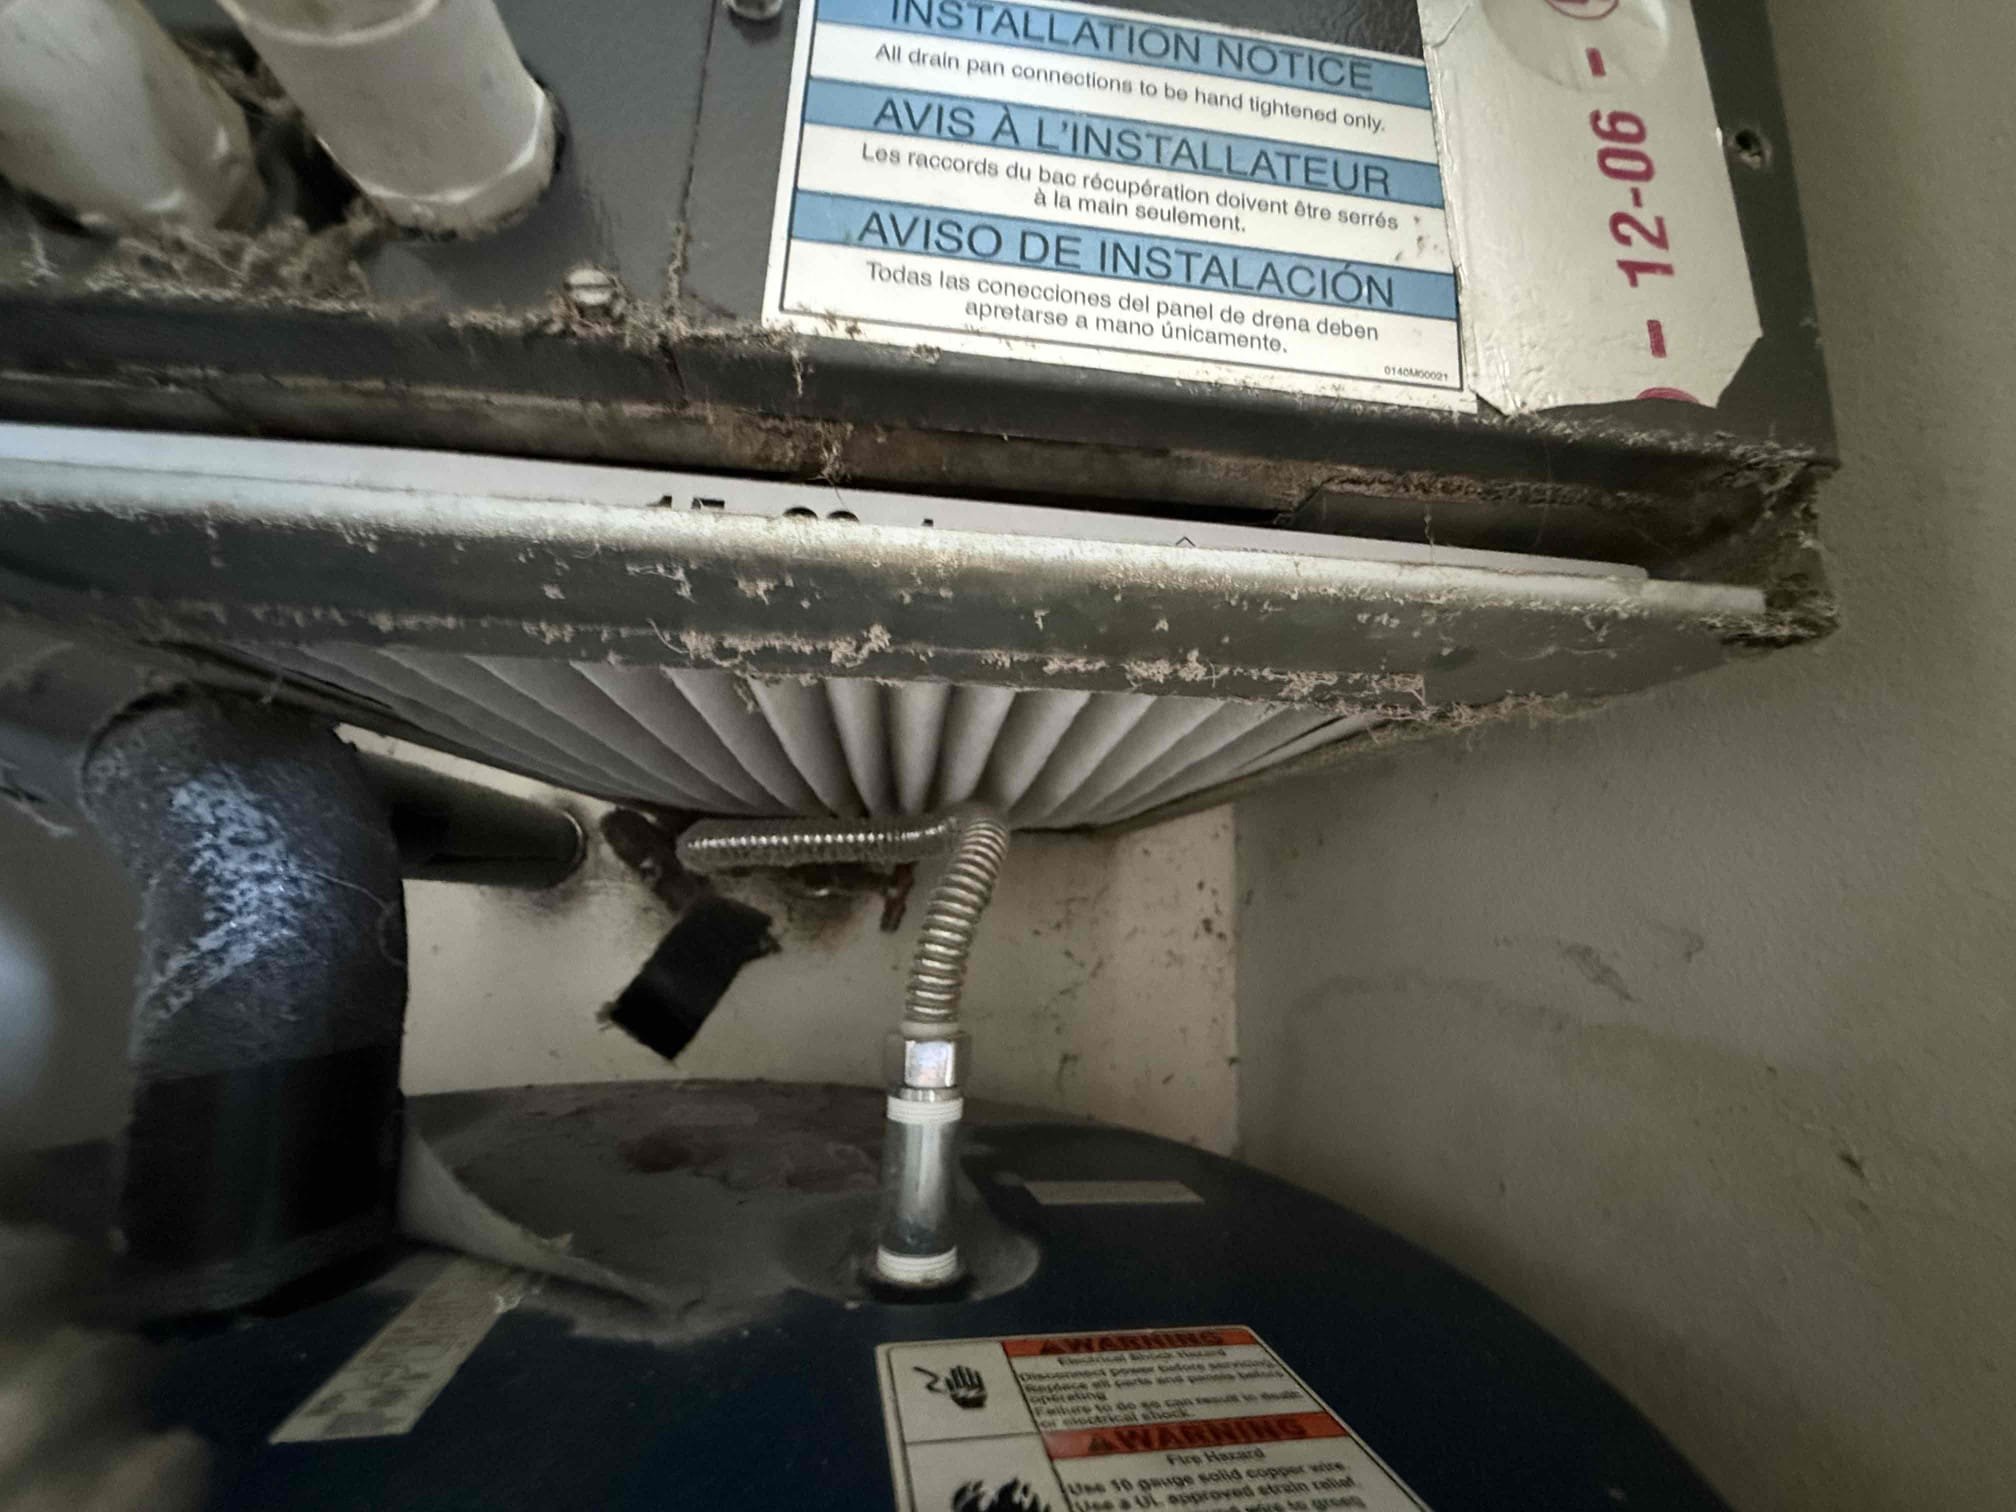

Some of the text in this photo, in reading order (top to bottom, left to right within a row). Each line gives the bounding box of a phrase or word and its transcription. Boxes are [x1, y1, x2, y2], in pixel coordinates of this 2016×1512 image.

[875, 43, 1386, 135] All drain pan connections to be hand tightened only.
[892, 0, 1374, 93] INSTALLATION NOTICE
[861, 142, 1400, 232] Les raccords du bac récupération doivent être serrés
[873, 97, 1390, 197] AVIS À L'INSTALLATEUR
[1033, 187, 1247, 233] à la main seulement.
[1590, 109, 1675, 288] 12-06
[858, 210, 1394, 309] AVISO DE INSTALACIÓN
[865, 260, 1379, 342] Todas las conecciones del panel de drena deben
[964, 299, 1288, 353] apretarse a mano únicamente.
[1115, 1419, 1305, 1452] WARNING
